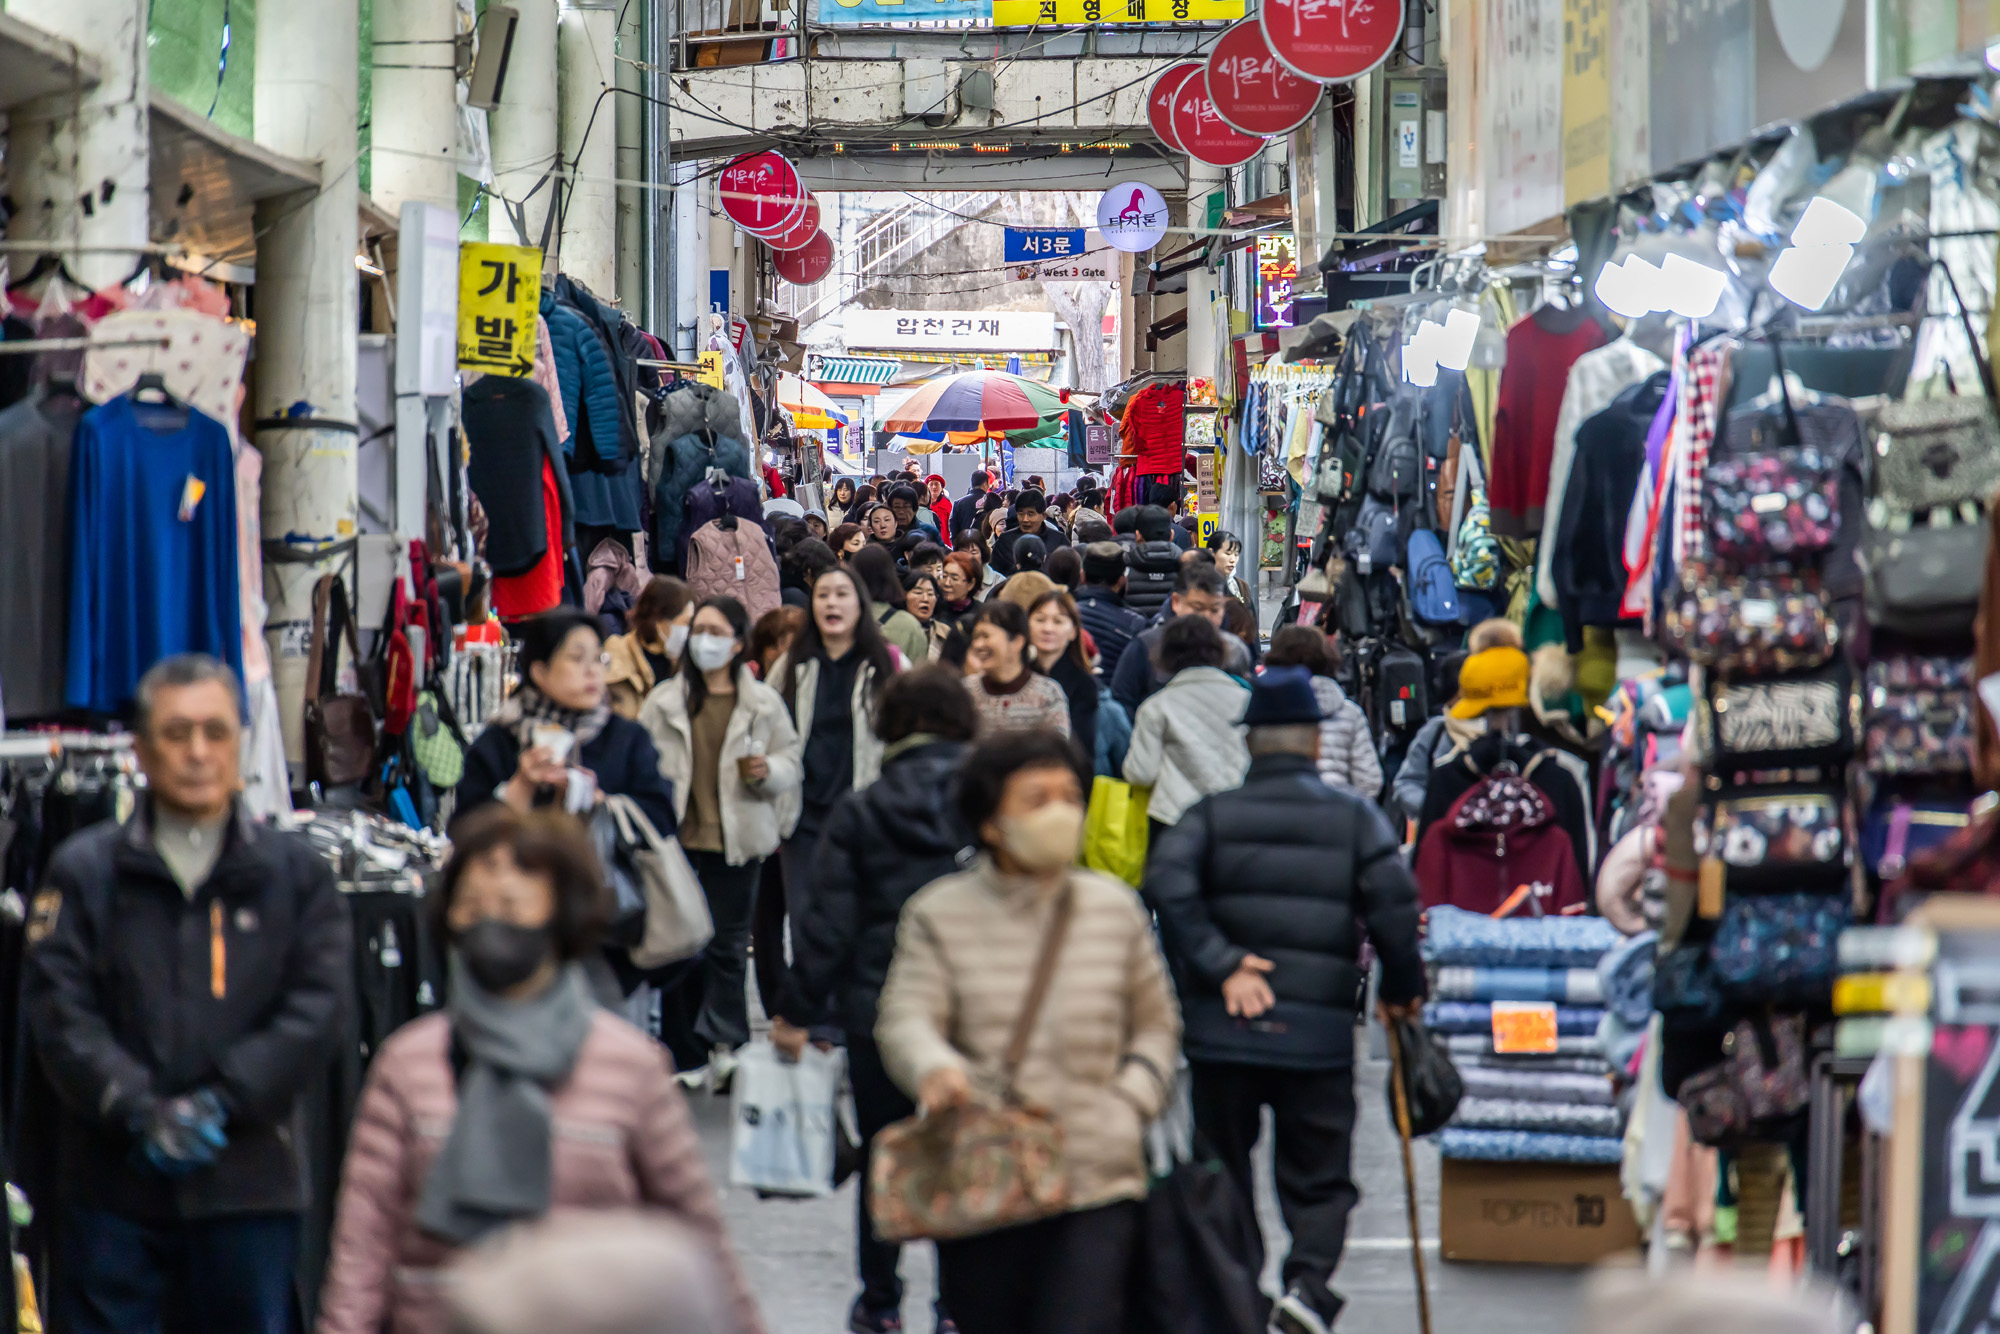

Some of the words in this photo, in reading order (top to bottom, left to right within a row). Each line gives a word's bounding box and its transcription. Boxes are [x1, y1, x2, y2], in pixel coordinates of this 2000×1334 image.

[1040, 0, 1190, 22] 직영매장
[1334, 45, 1373, 54] MARKET
[1268, 104, 1300, 113] MARKET
[726, 168, 768, 191] 서문시장
[752, 194, 762, 221] 1
[769, 192, 792, 207] 지구
[1022, 235, 1072, 255] 서3문
[797, 257, 806, 278] 1
[810, 256, 829, 266] 지구
[1043, 268, 1069, 277] West
[1071, 266, 1079, 277] 3
[1081, 268, 1106, 277] Gate
[476, 260, 521, 360] 가발
[896, 318, 1000, 336] 합천건재
